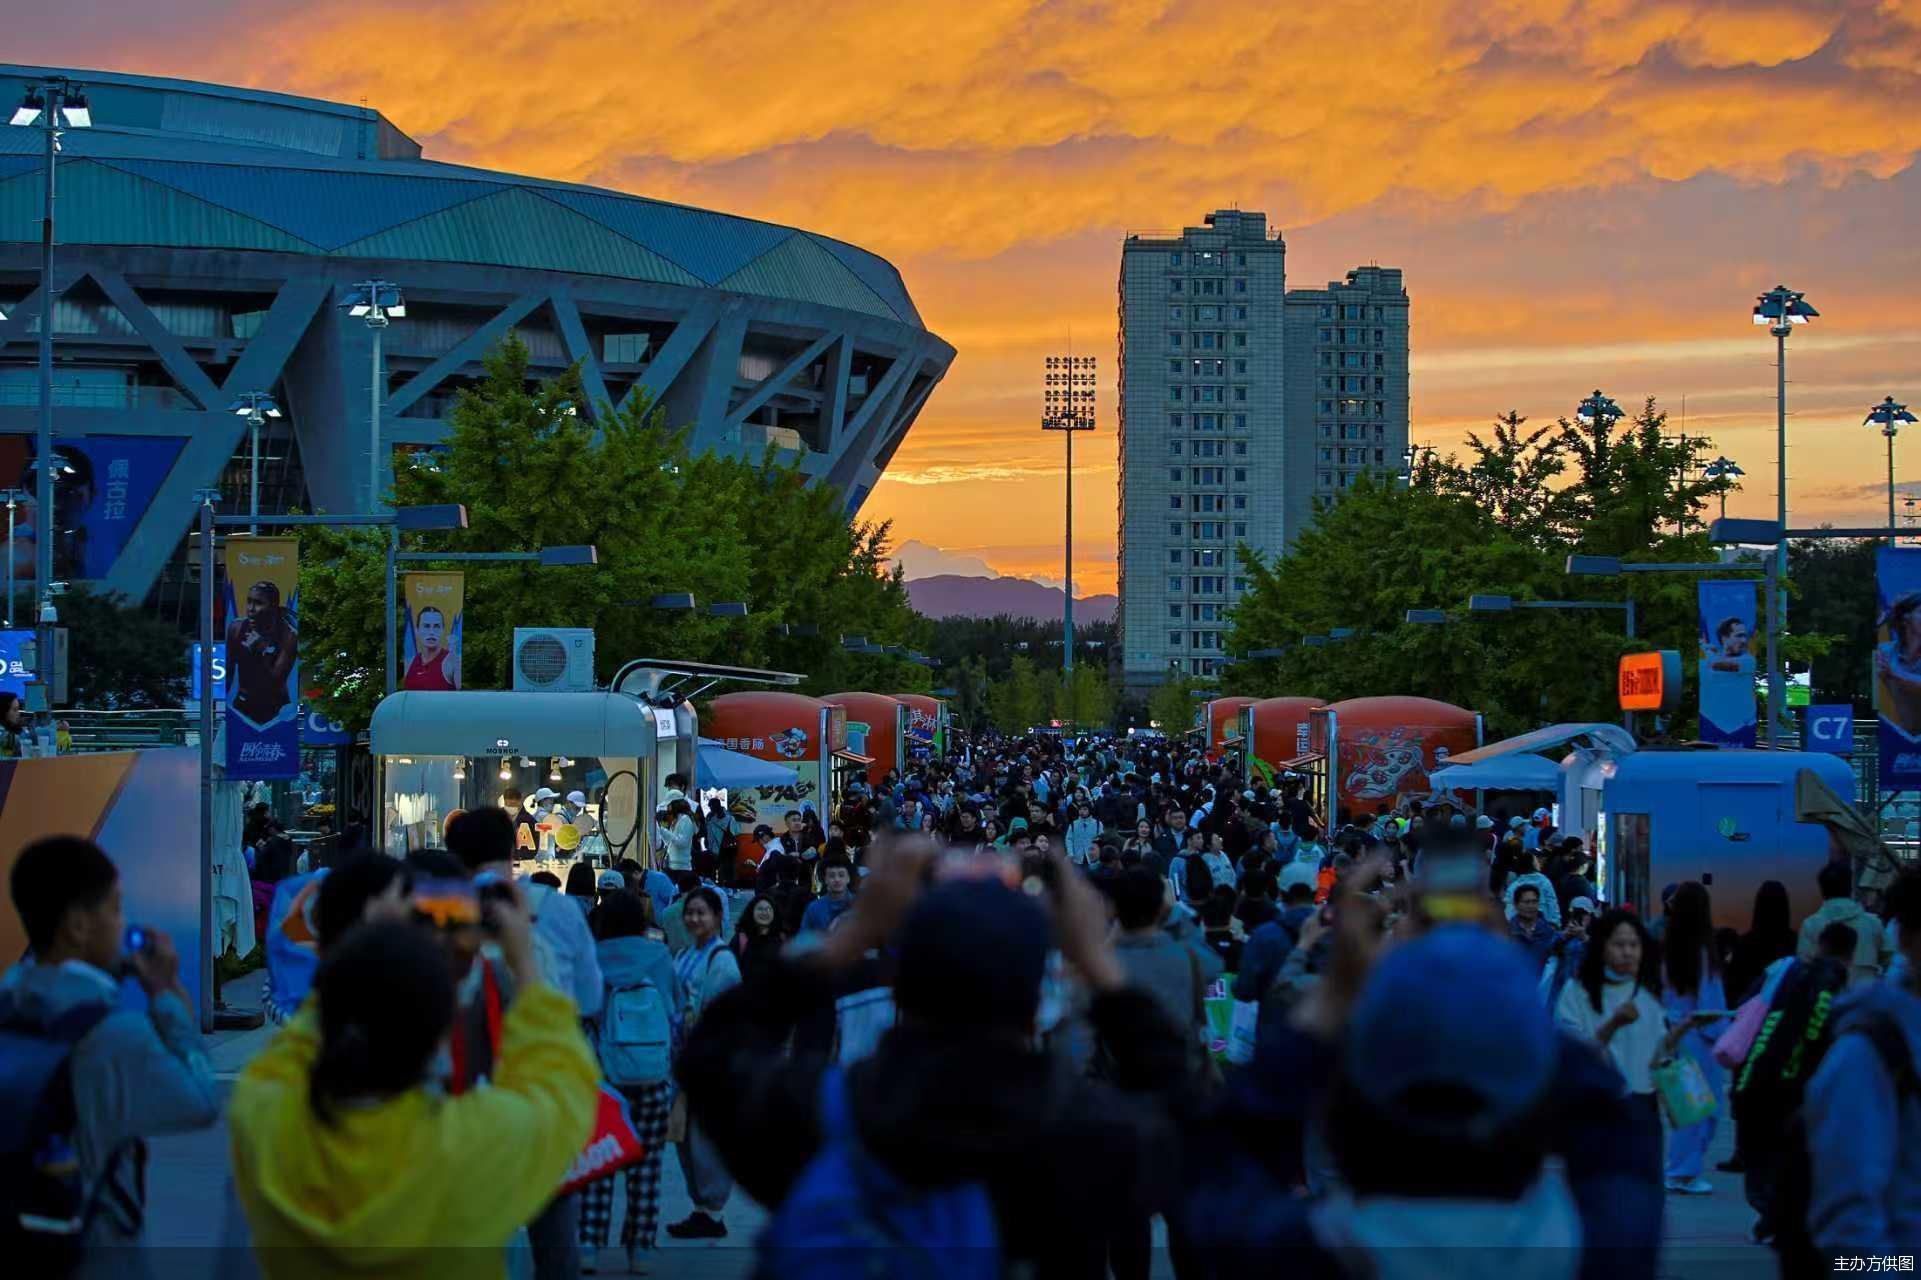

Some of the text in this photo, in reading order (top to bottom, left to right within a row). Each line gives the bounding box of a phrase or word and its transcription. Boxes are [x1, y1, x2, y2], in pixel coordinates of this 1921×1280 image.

[1812, 716, 1848, 740] C7
[718, 737, 765, 750] 国香肠
